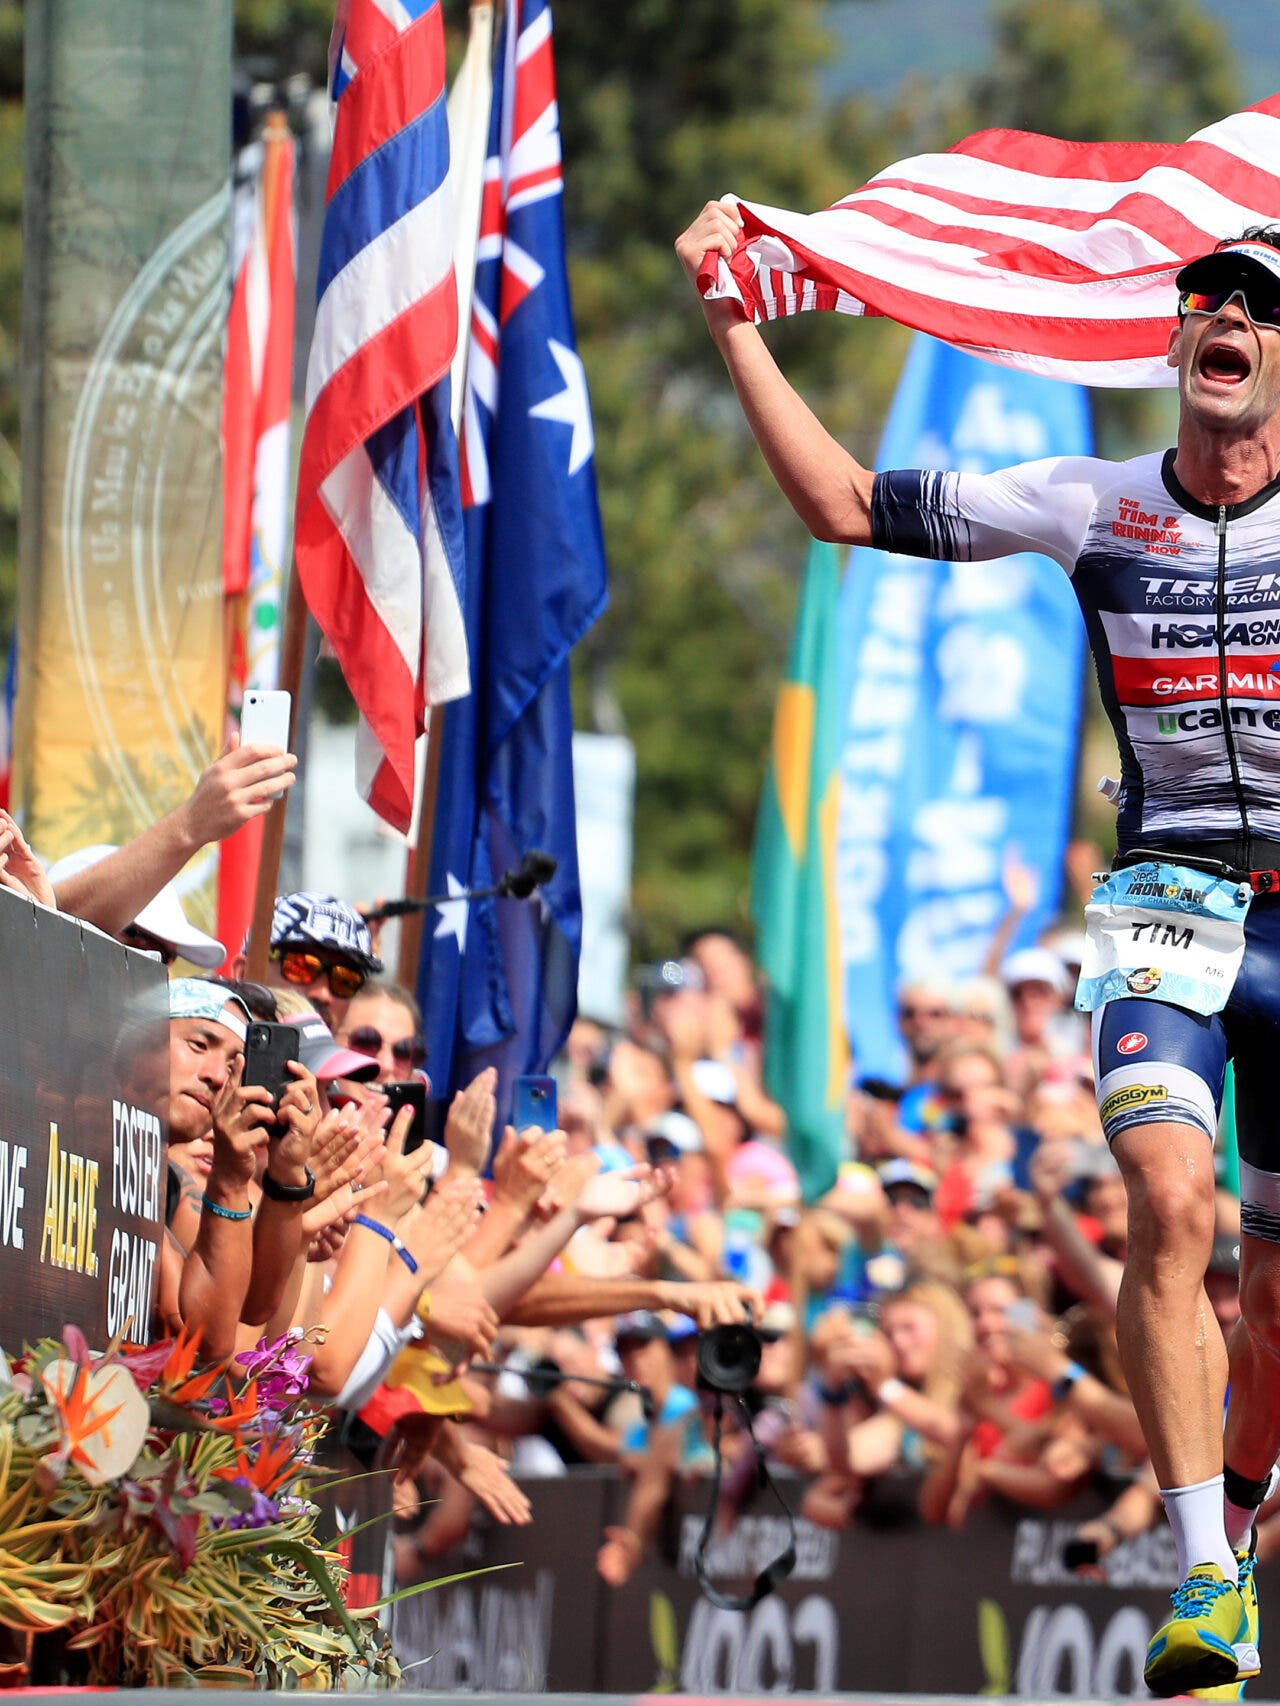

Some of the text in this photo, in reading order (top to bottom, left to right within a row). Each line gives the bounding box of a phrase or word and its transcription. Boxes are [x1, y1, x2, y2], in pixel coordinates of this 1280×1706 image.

[1119, 497, 1141, 508] THE
[1118, 506, 1181, 529] TIM &
[1111, 521, 1184, 545] RINNY
[1144, 544, 1182, 555] SHOW
[1145, 594, 1216, 607] FACTORY
[1151, 622, 1250, 648] HOKA
[1125, 882, 1208, 904] IRONAN
[1131, 922, 1195, 950] TIM
[112, 1099, 161, 1222] FOSTER
[40, 1121, 99, 1275] ALEVE
[107, 1227, 157, 1346] GRANT
